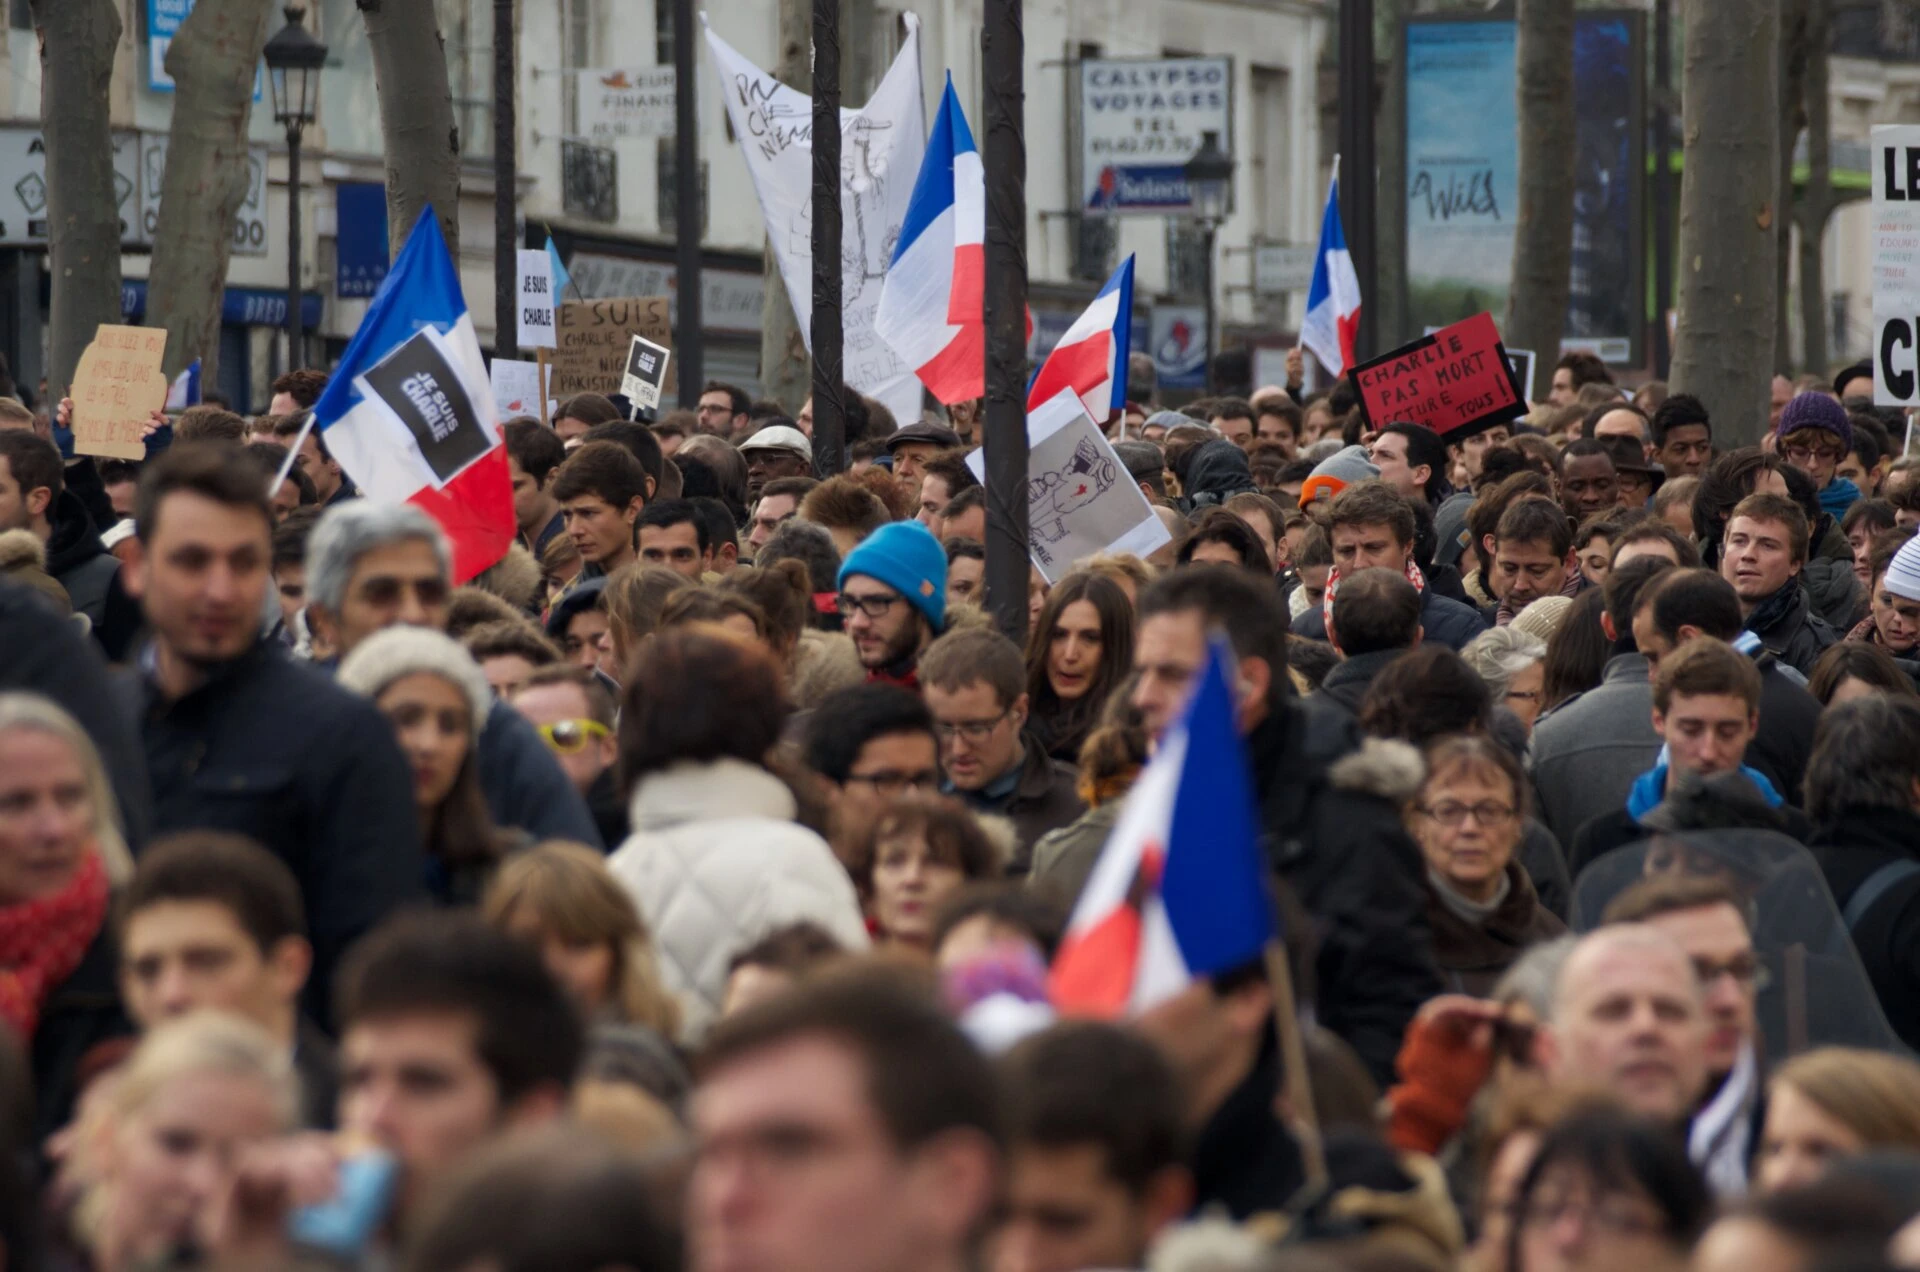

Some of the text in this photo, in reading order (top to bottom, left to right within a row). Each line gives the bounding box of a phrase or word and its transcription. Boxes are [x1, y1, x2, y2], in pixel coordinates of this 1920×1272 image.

[1090, 68, 1221, 85] CALYPSO
[1090, 92, 1221, 111] VOYAGES
[1133, 117, 1176, 132] TEL
[1408, 170, 1500, 220] Wild
[524, 275, 532, 293] JE
[532, 275, 548, 293] SUIS
[524, 307, 552, 327] CHARLIE
[592, 300, 662, 326] SUIS
[565, 332, 616, 347] CHARLIE
[1361, 334, 1463, 388] CHARLIE
[1380, 378, 1419, 406] PAS
[1435, 350, 1486, 386] MORT
[401, 378, 448, 442] CHARLIE
[415, 371, 459, 433] JE SUIS
[1455, 392, 1494, 419] TOUS
